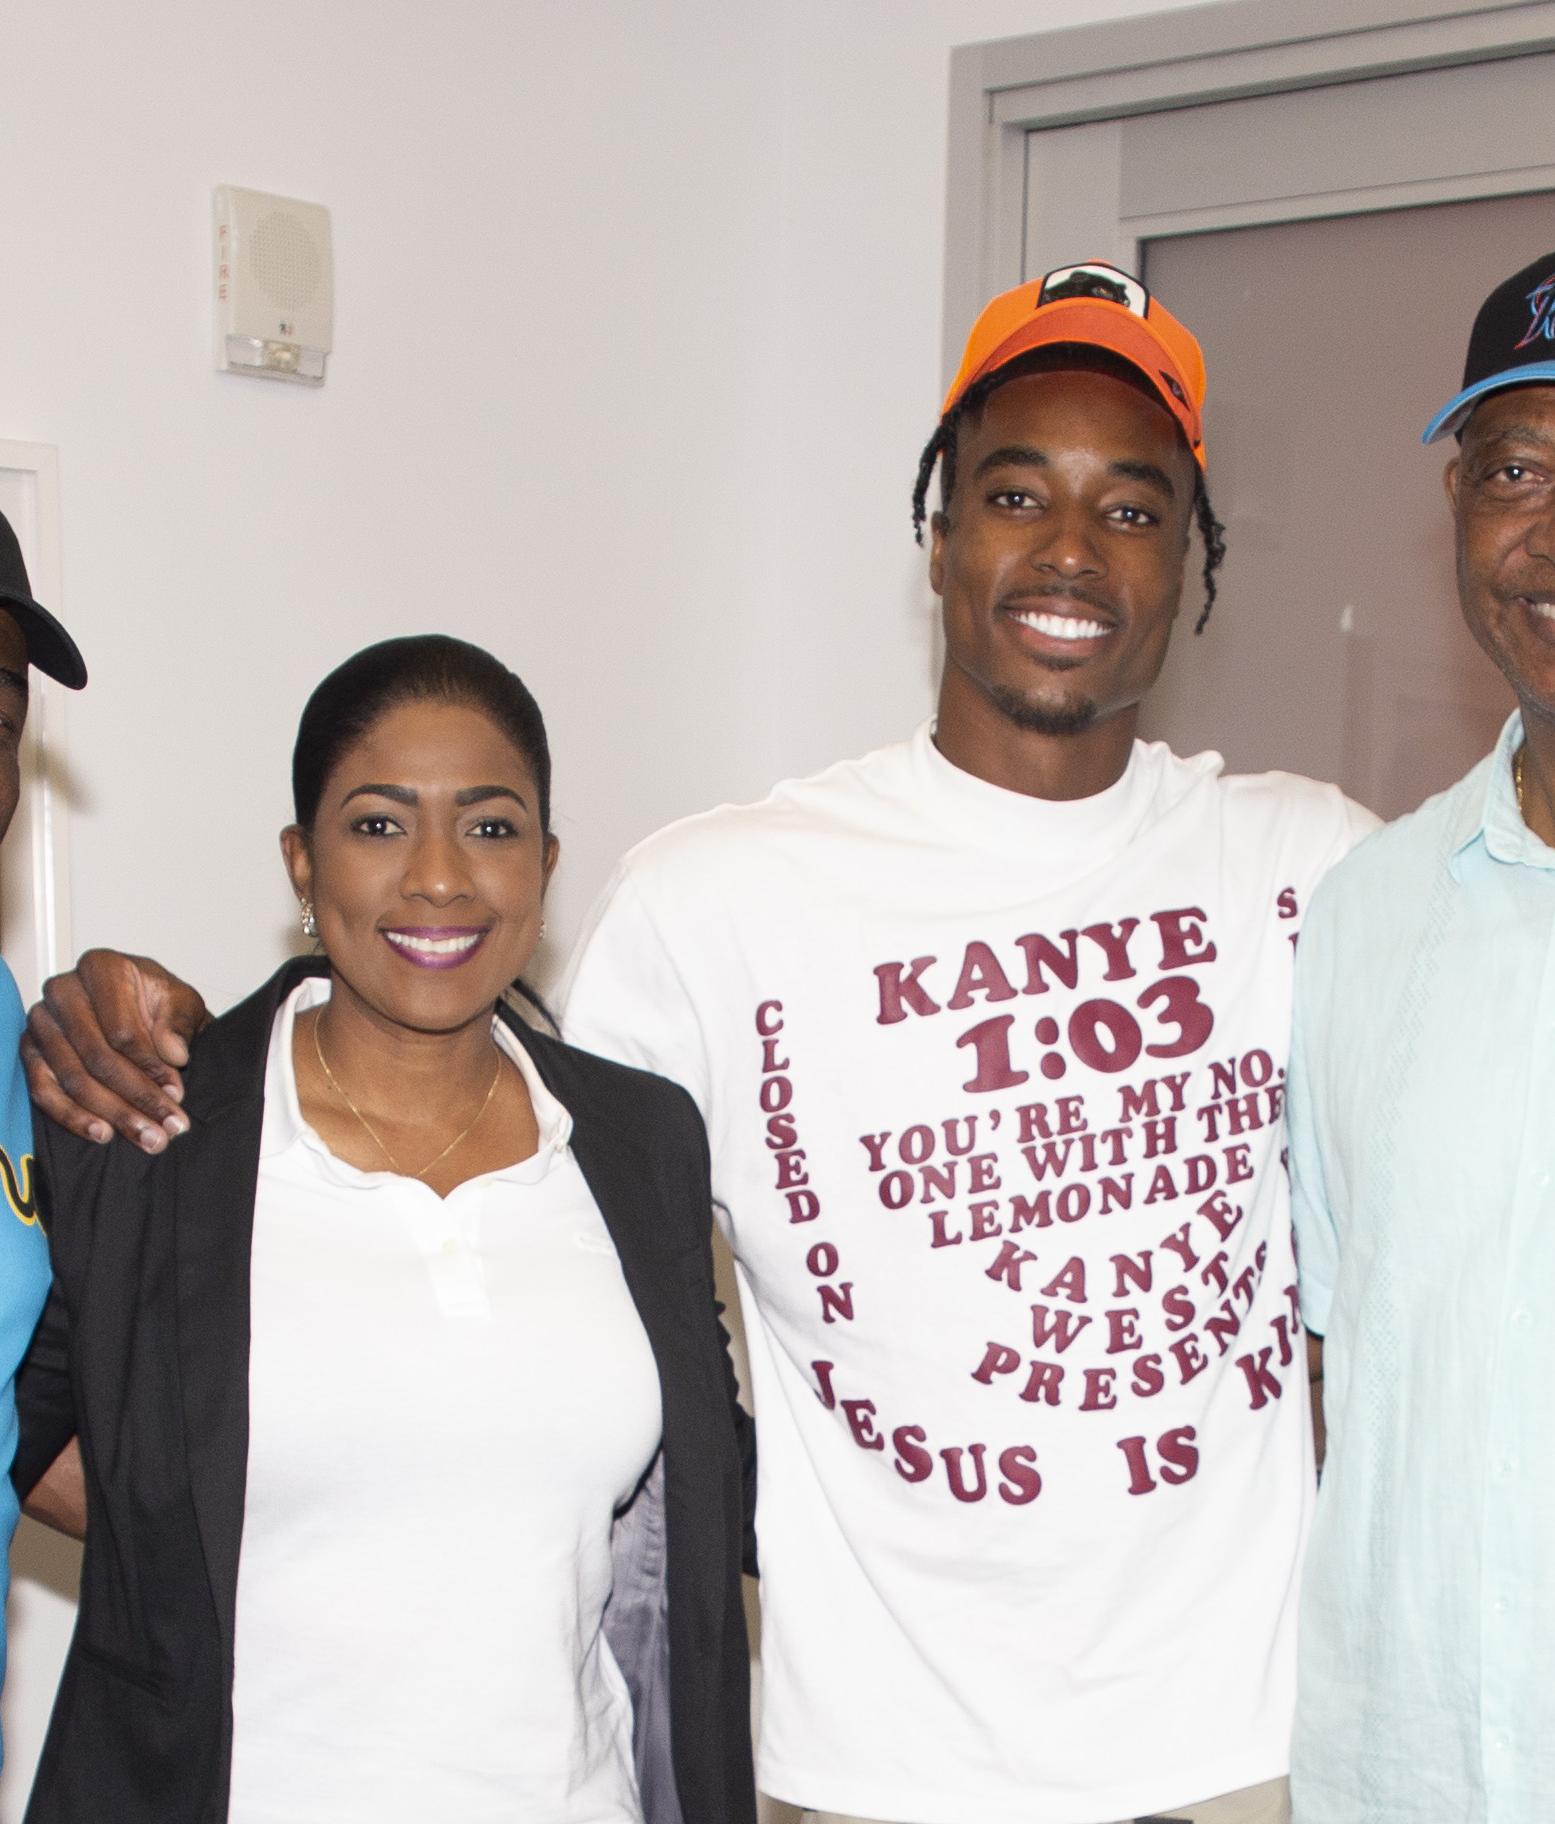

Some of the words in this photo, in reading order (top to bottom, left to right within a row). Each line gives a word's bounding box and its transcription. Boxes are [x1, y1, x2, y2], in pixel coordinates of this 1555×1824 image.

[219, 224, 230, 301] FIRE
[873, 907, 1216, 1024] KANYE
[956, 976, 1213, 1092] 1:03
[756, 1000, 821, 1224] CLOSED
[806, 1241, 855, 1324] ON
[859, 1095, 1089, 1173] YOU'RE
[1117, 1071, 1192, 1123] MY
[1207, 1048, 1286, 1100] NO.
[878, 1152, 1002, 1210] ONE
[1021, 1115, 1178, 1182] WITH
[1196, 1083, 1287, 1143] THE
[928, 1143, 1255, 1249] LEMONADE
[985, 1189, 1243, 1304] KANYE
[1030, 1250, 1230, 1355] WEST
[811, 1360, 1042, 1505] JESUS
[1117, 1425, 1200, 1496] IS
